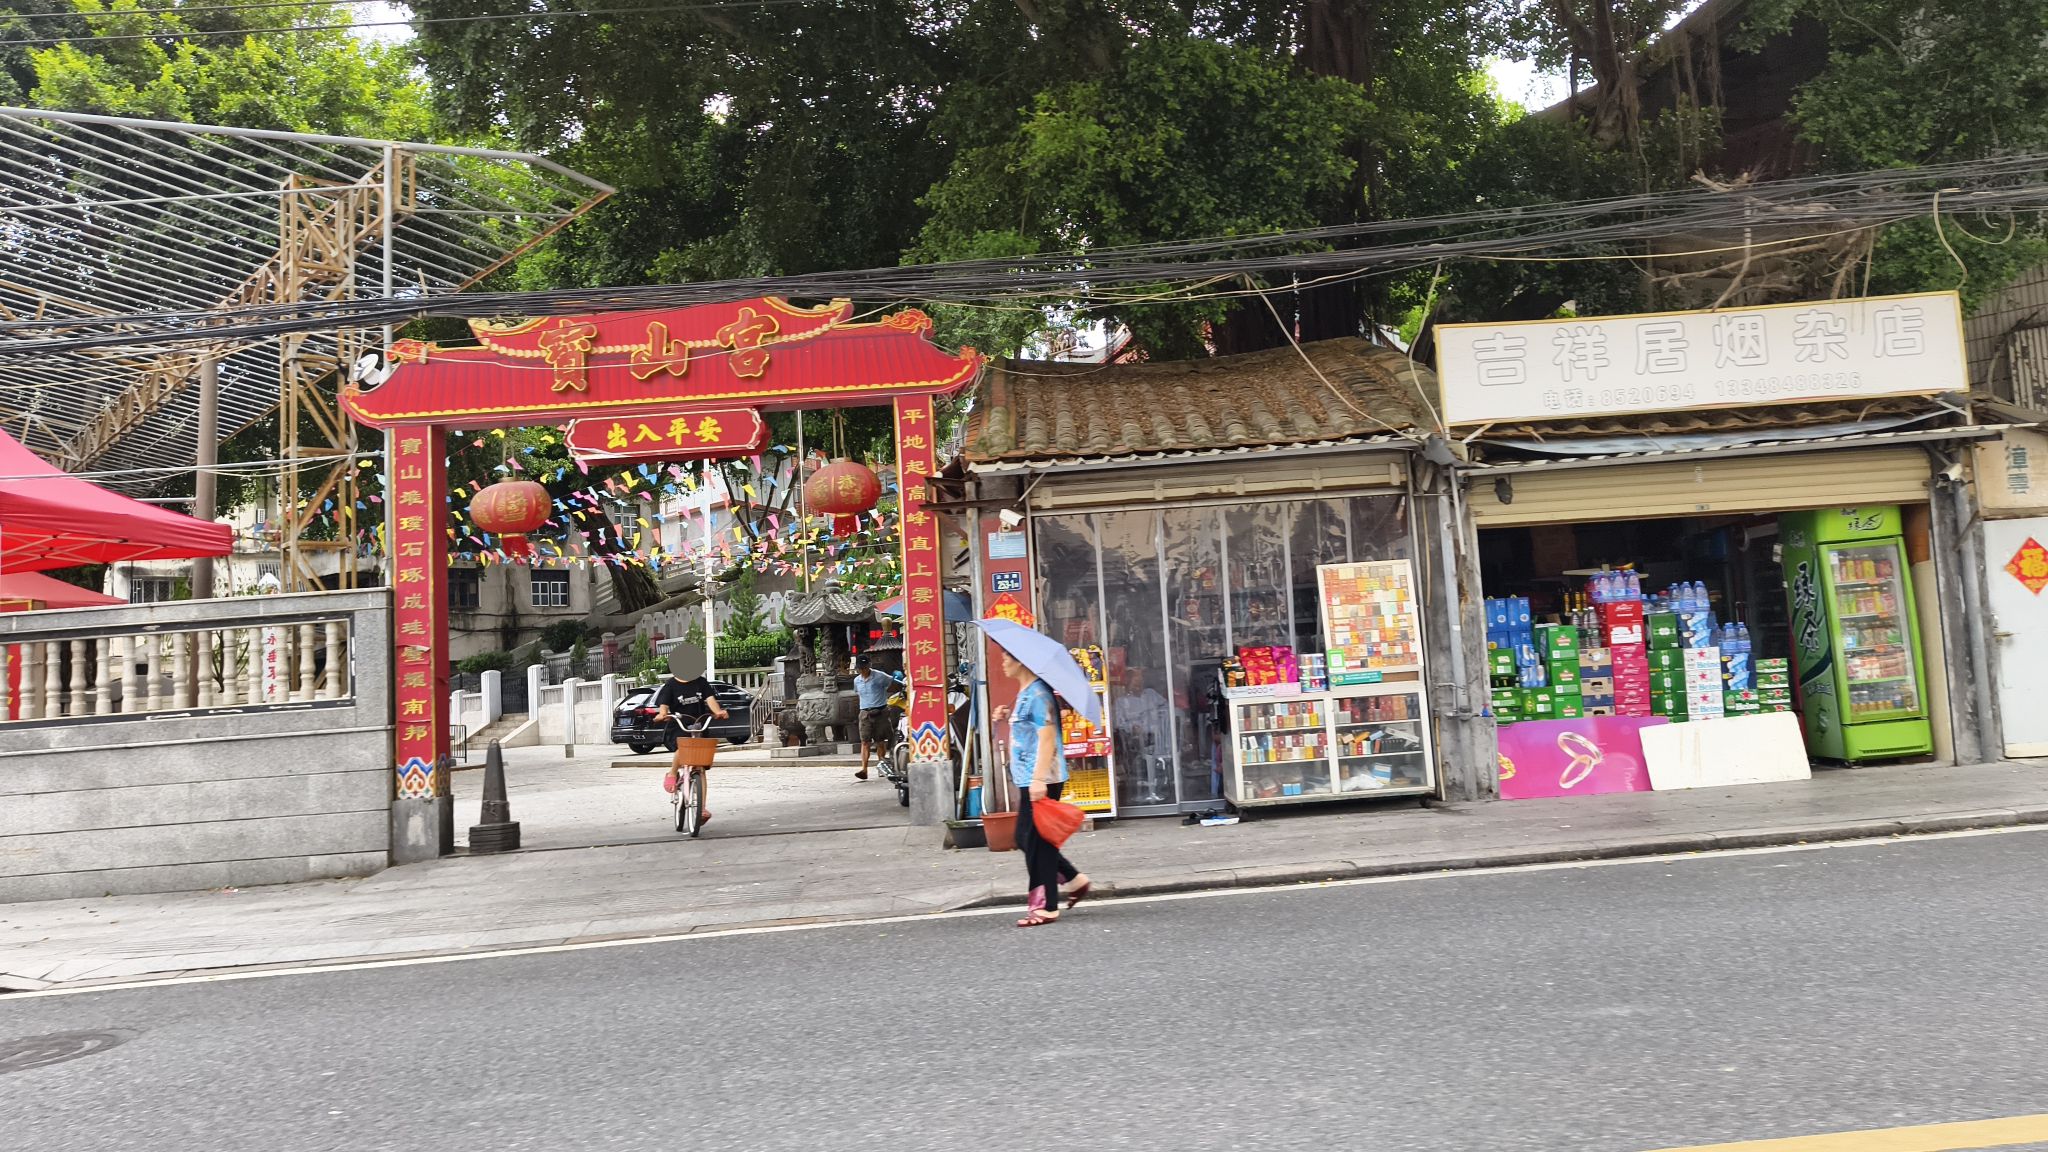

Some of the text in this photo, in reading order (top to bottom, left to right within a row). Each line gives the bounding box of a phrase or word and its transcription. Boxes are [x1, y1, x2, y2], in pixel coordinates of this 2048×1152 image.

[539, 307, 780, 392] 寶山宮
[1472, 303, 1926, 388] 吉祥居烟杂店
[605, 413, 724, 450] 出入平安
[997, 579, 1019, 591] 253-1
